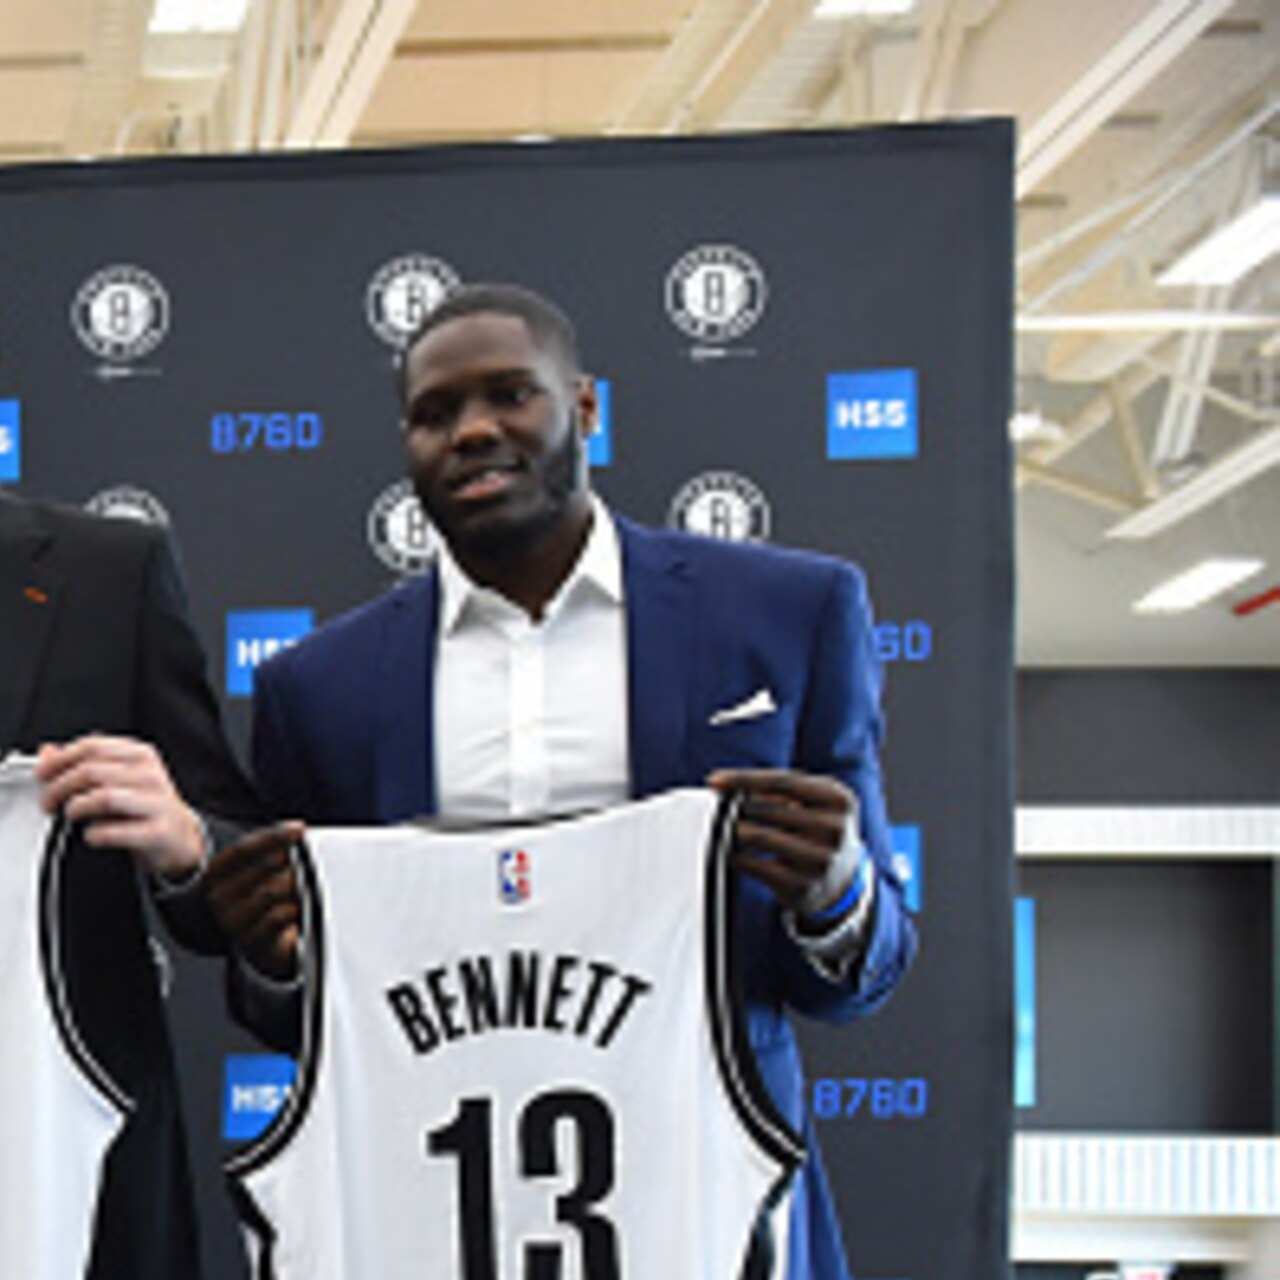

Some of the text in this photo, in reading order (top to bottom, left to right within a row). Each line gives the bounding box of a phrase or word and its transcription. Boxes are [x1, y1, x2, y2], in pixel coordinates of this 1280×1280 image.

[211, 412, 321, 454] 8760
[836, 400, 907, 429] HSS
[386, 951, 651, 1056] BENNETT
[813, 1078, 927, 1119] 8760
